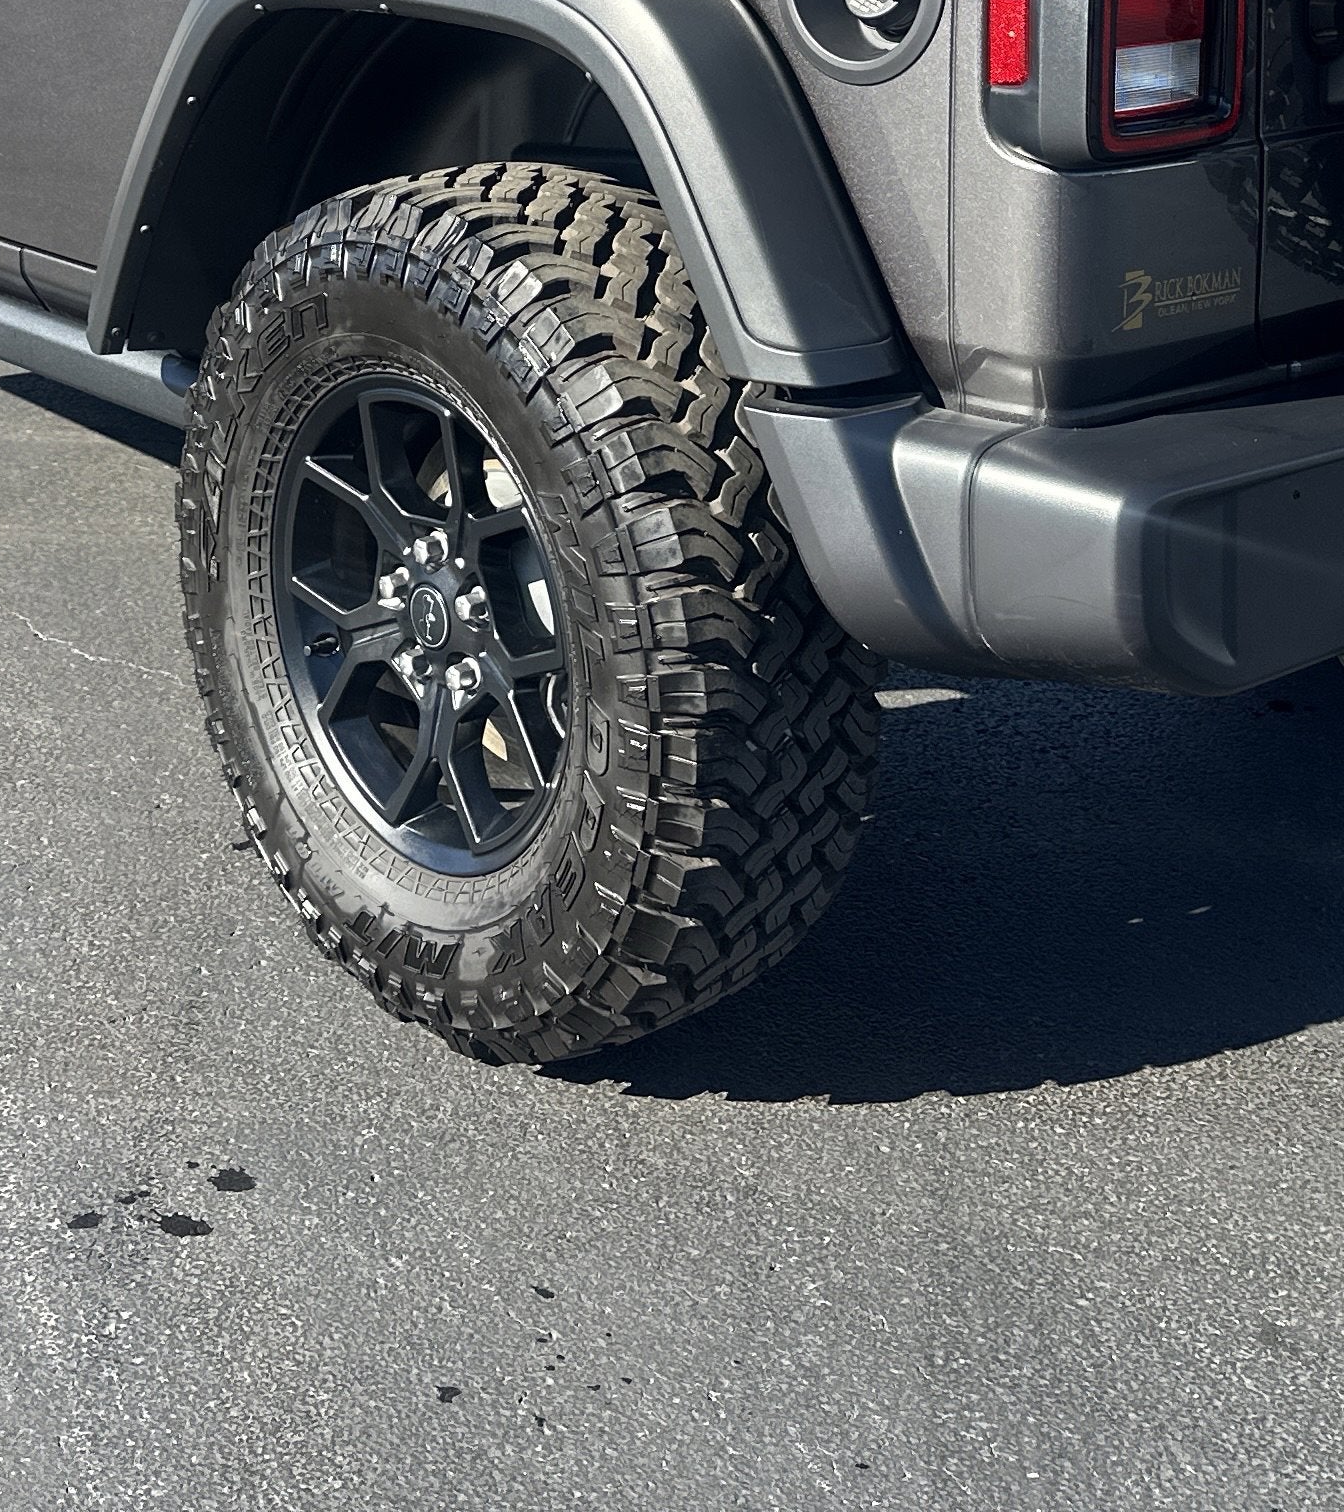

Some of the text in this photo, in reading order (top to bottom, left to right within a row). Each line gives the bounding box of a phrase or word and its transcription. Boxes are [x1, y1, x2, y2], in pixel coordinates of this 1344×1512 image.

[1155, 268, 1241, 301] RICK BOKMAN
[490, 488, 609, 975] WILDPEAK
[342, 910, 465, 979] M/T
